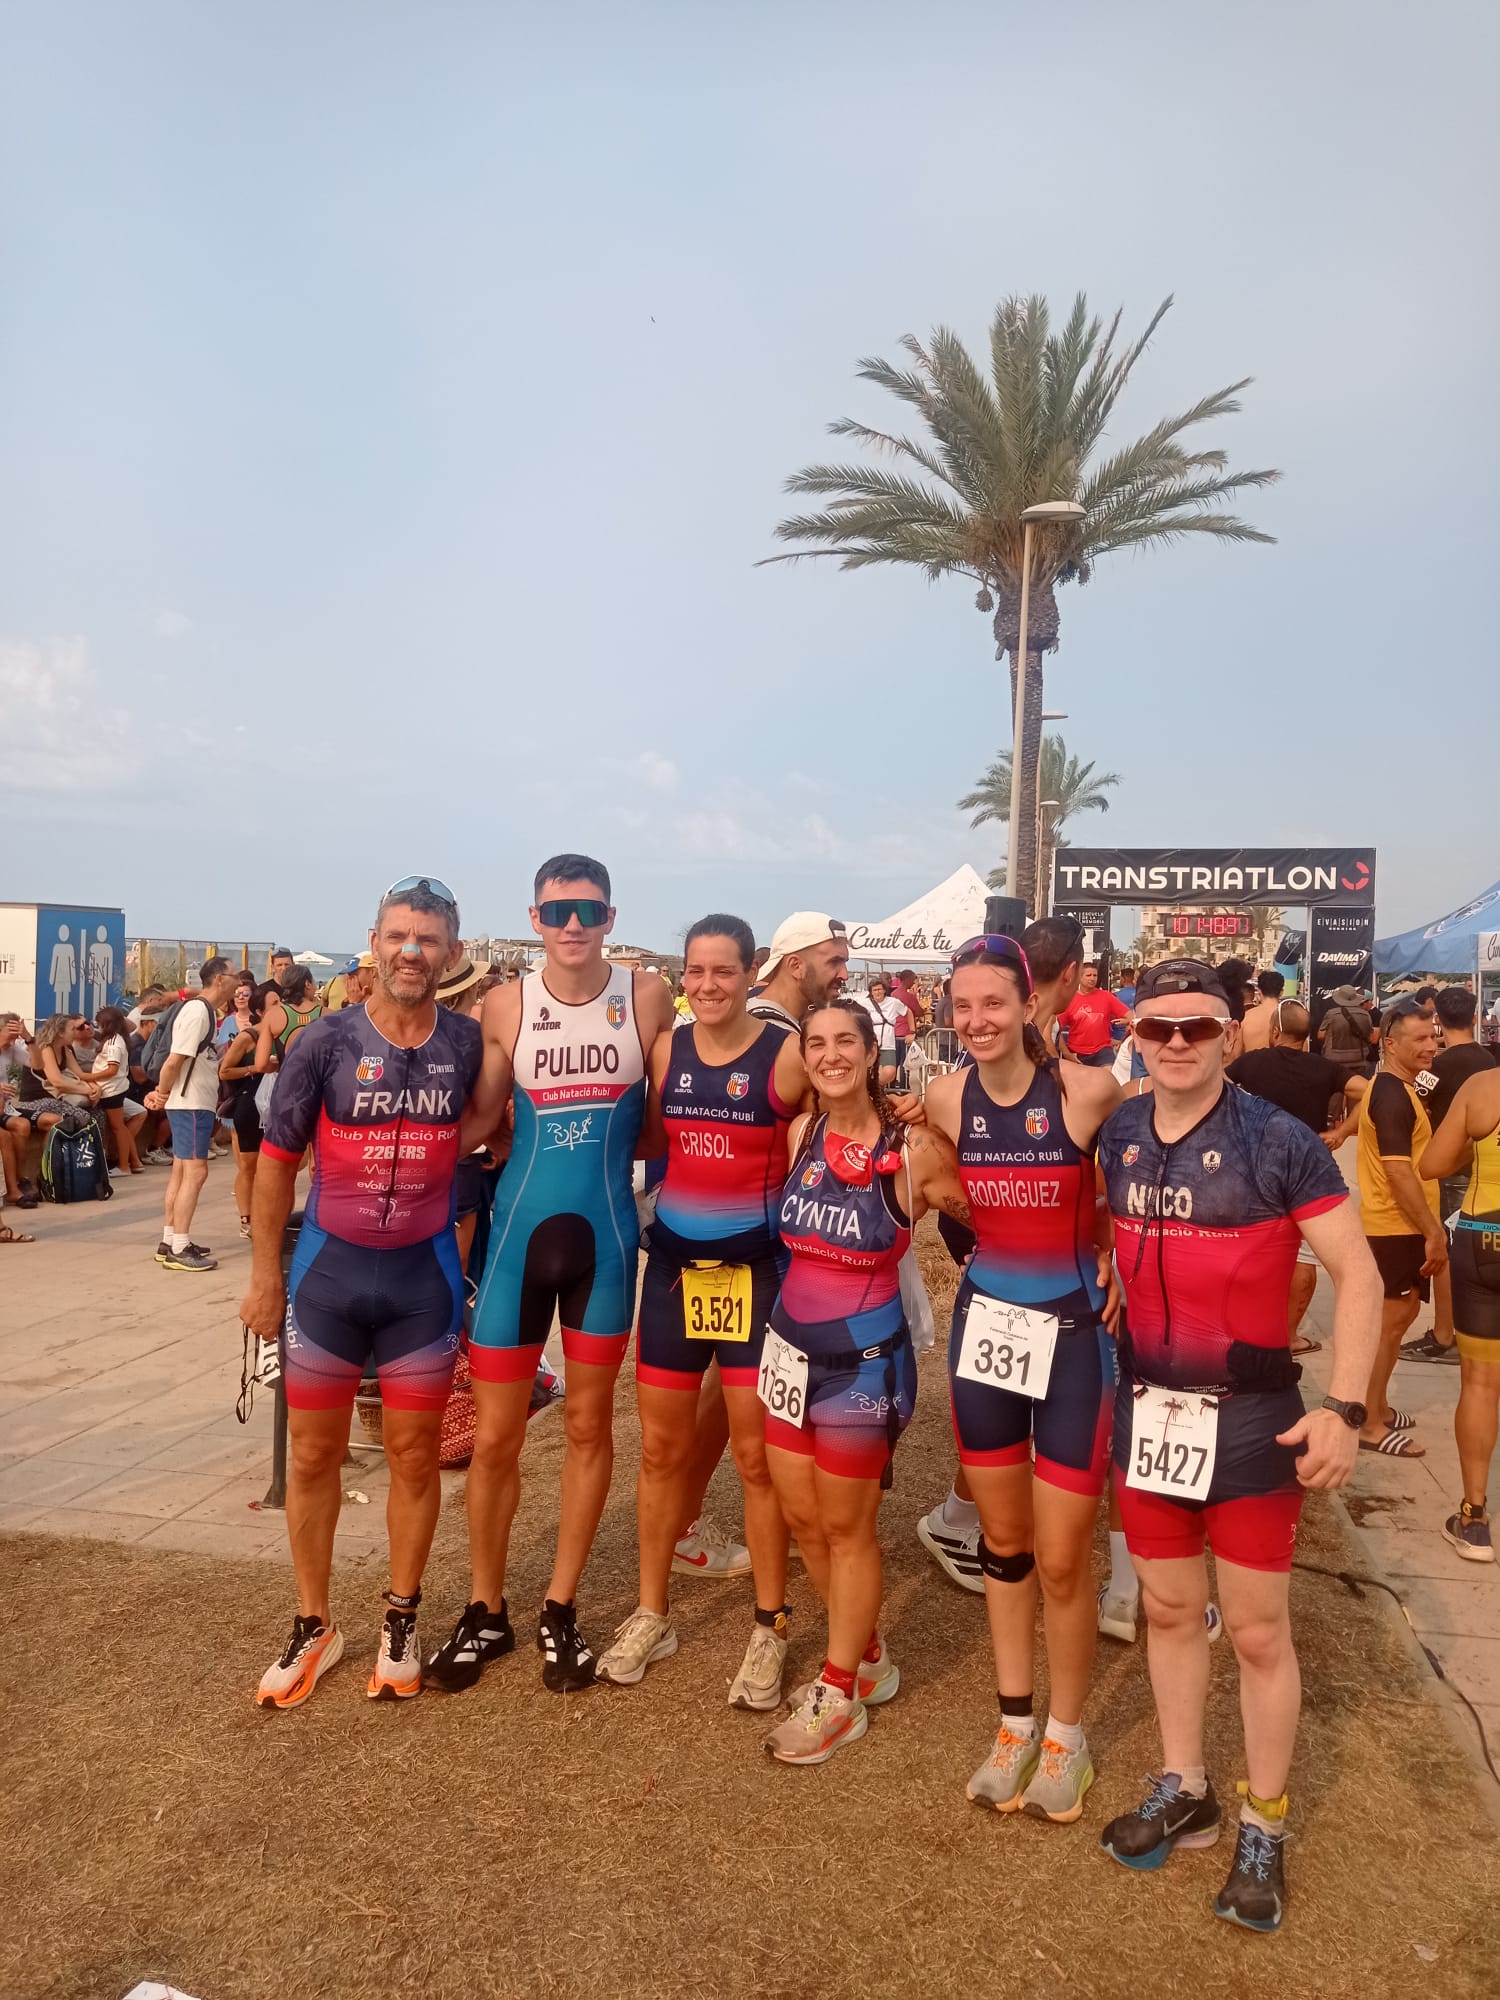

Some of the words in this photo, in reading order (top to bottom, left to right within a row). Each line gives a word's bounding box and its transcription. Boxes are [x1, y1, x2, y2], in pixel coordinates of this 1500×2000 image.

[1060, 866, 1337, 890] TRANSTRIATLON
[850, 926, 905, 950] Cunit
[903, 928, 930, 950] ets
[933, 928, 953, 951] tu
[1317, 951, 1360, 963] DAVIMA
[608, 996, 624, 1005] CNR
[532, 1021, 561, 1032] VIATOR
[361, 1056, 383, 1065] CNR
[534, 1044, 619, 1079] PULIDO
[352, 1088, 453, 1118] FRANK
[543, 1092, 559, 1102] Club
[560, 1087, 591, 1100] Natació
[665, 1105, 683, 1114] CLUB
[685, 1107, 729, 1119] NATACIÓ
[732, 1111, 755, 1122] RUBÍ
[1027, 1109, 1046, 1118] CNR
[331, 1127, 363, 1141] Club
[367, 1129, 434, 1141] Natació
[680, 1131, 735, 1159] CRISOL
[362, 1145, 427, 1160] 226ERS
[962, 1152, 982, 1162] CLUB
[985, 1149, 1035, 1162] NATACIÓ
[1038, 1148, 1063, 1161] RUBÍ
[967, 1172, 1061, 1208] RODRÍGUEZ
[781, 1194, 862, 1240] CYNTIA
[793, 1240, 839, 1260] Natació
[842, 1256, 876, 1267] Rubí
[691, 1296, 743, 1334] 3.521
[975, 1338, 1031, 1386] 331
[1136, 1437, 1208, 1487] 5427
